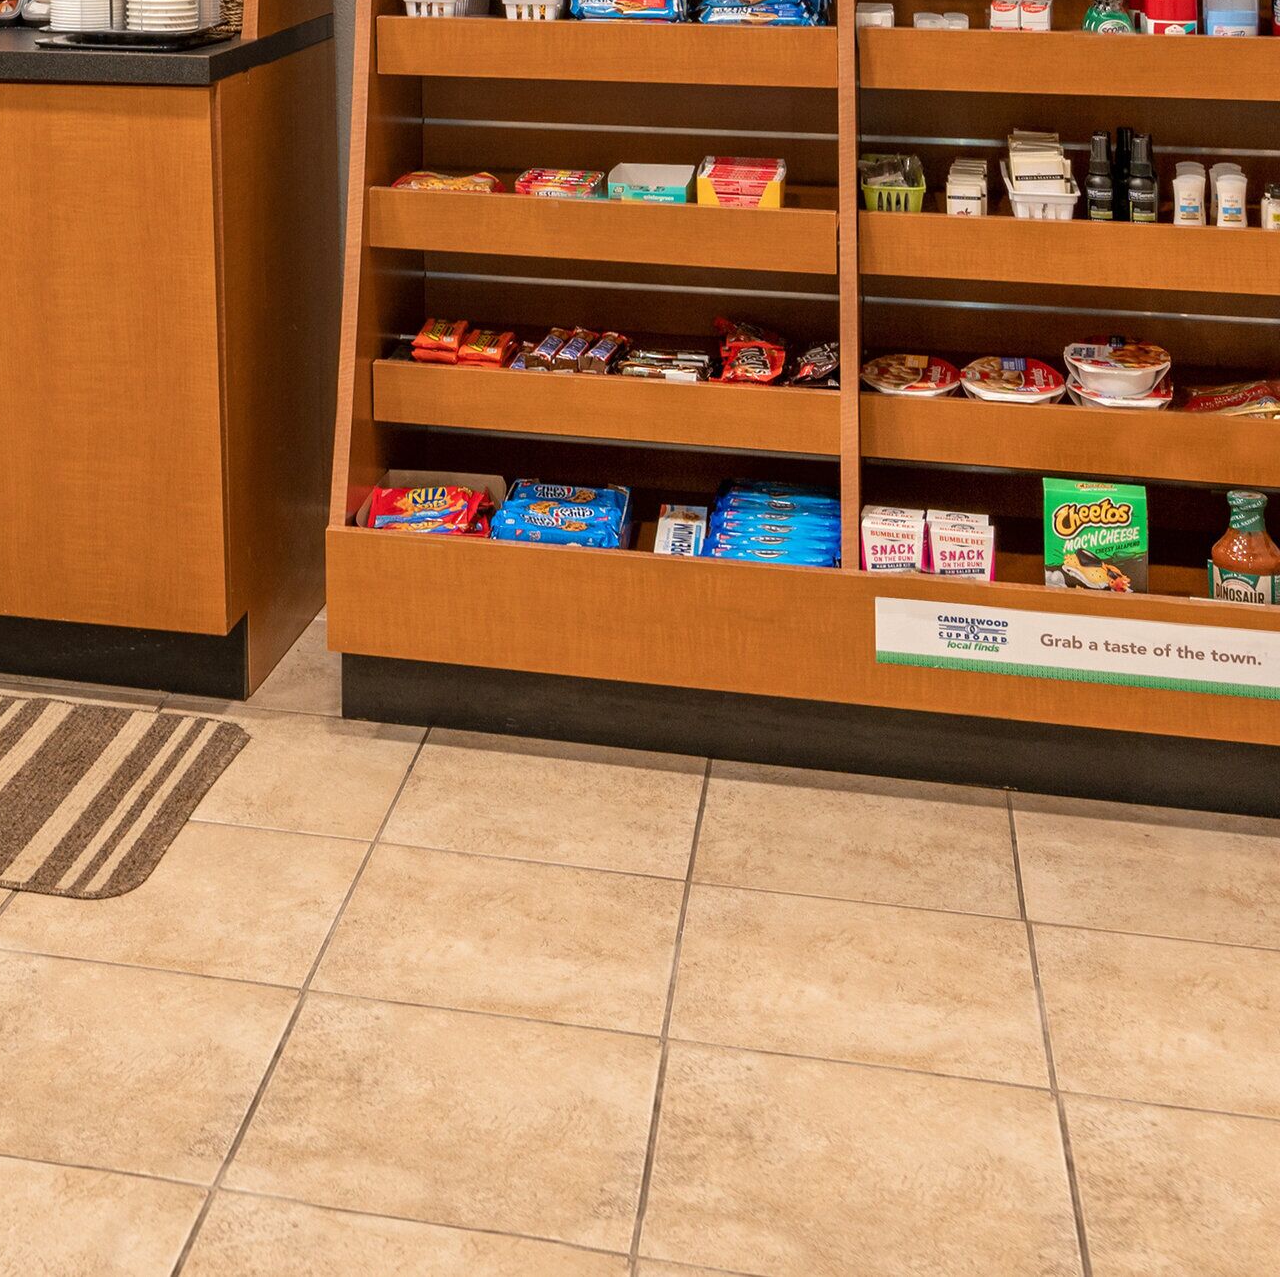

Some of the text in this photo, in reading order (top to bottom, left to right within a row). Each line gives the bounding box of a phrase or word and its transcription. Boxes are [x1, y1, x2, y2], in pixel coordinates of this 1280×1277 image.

[993, 4, 1014, 12] Colgate
[407, 487, 447, 504] RITZ
[1053, 497, 1133, 539] Cheetos
[870, 530, 916, 540] BUMBLE BEE
[939, 535, 985, 545] BUMBLE BEE
[1099, 527, 1140, 545] CHEESE
[871, 544, 915, 555] SNACK
[940, 550, 985, 561] SNACK
[1095, 544, 1115, 554] CHEESY
[1215, 582, 1265, 604] DINOSAUR
[937, 614, 1009, 628] CANDLEWOOD
[938, 630, 1008, 644] CUPBOARD
[947, 639, 1000, 653] local finds
[1039, 633, 1263, 666] Grab a taste of the town.
